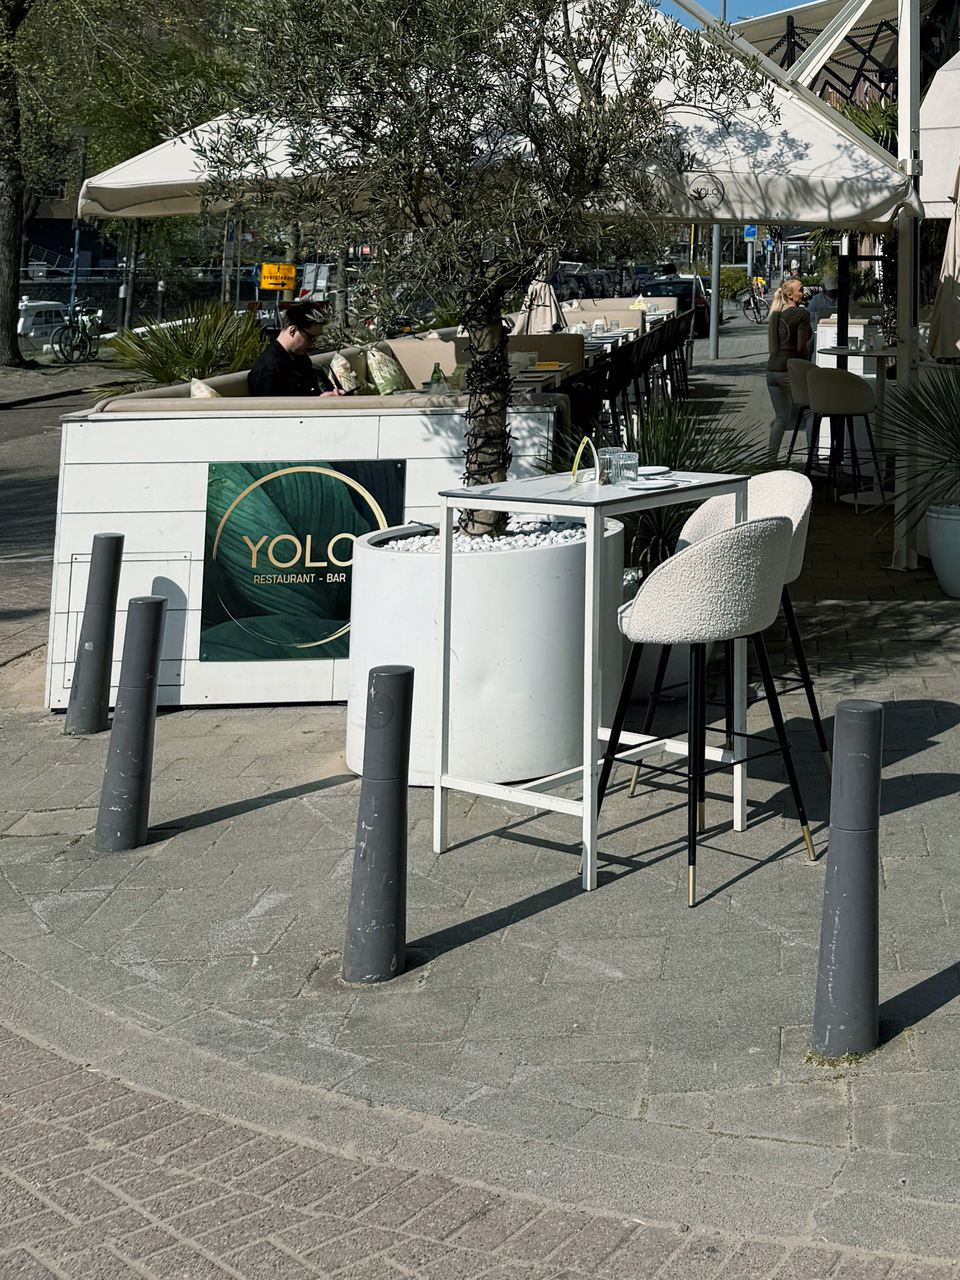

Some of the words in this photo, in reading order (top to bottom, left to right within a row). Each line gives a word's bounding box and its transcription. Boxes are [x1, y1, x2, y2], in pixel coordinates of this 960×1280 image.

[693, 187, 719, 197] OLO
[242, 532, 358, 570] YOLO
[253, 573, 316, 585] RESTAURANT
[326, 572, 347, 583] BAR
